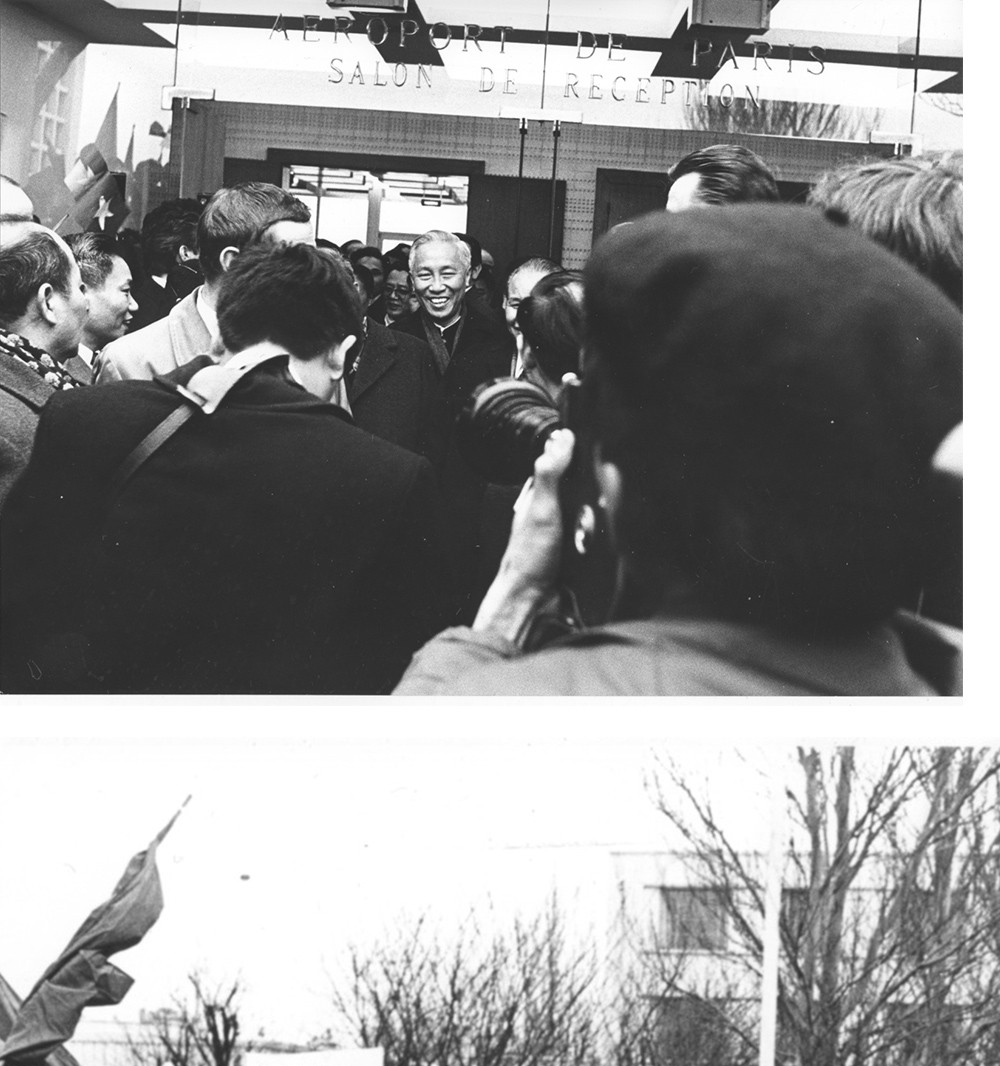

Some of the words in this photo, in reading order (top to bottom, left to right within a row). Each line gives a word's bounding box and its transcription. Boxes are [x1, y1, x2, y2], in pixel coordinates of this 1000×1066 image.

[268, 13, 515, 54] AEROPORT
[575, 30, 628, 62] DE
[690, 38, 827, 76] PARIS
[327, 57, 434, 90] SALON
[478, 65, 519, 96] DE
[562, 71, 762, 110] RECEPTION
